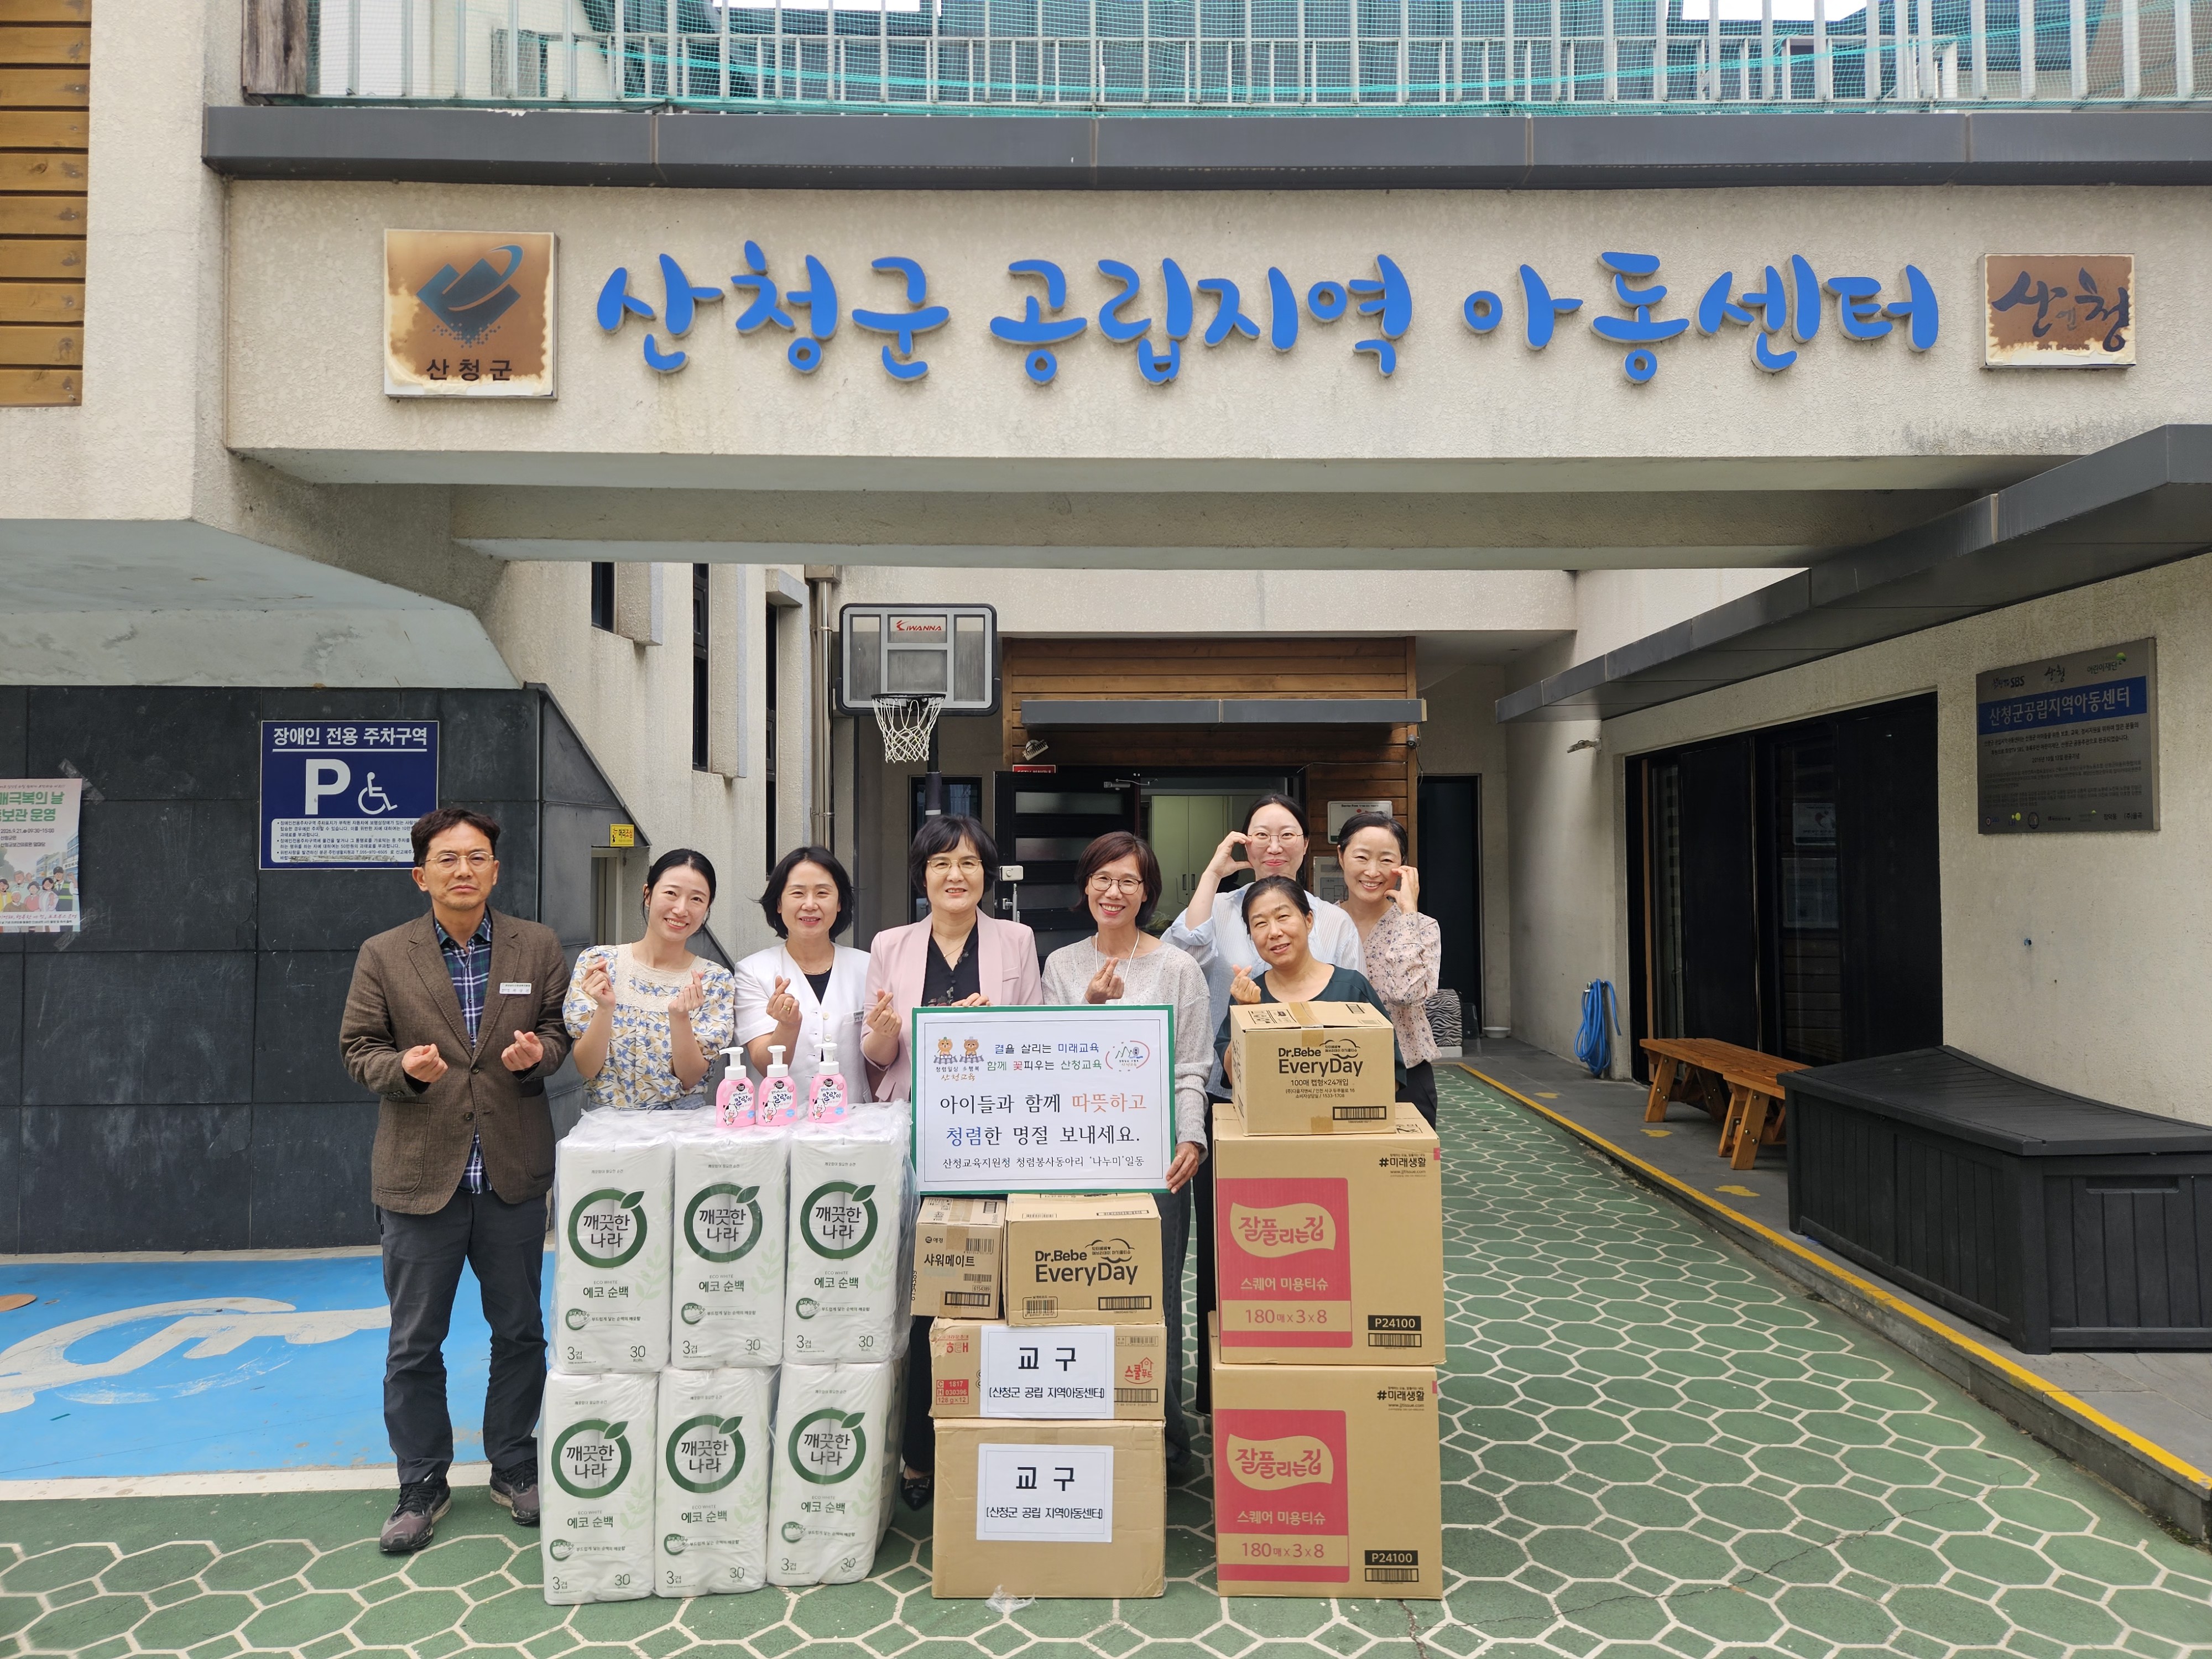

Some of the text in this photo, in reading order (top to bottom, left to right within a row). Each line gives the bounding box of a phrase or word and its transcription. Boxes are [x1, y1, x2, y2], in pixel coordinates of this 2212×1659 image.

[597, 240, 1939, 385] 산청군 공립지역 아동센터
[426, 359, 512, 381] 산청군
[896, 620, 942, 631] KIWANNA
[2088, 662, 2117, 675] 어린이재단
[2011, 676, 2025, 687] SBS
[1989, 686, 2129, 726] 산청군공립지역아동센터
[274, 727, 427, 745] 장애인 전용 주차구역
[305, 759, 351, 815] P
[51, 791, 65, 805] 날
[0, 808, 56, 822] 보관 운영
[995, 1042, 1099, 1054] 결을 살리는 미래교육
[1279, 1047, 1321, 1057] Dr.Bebe
[987, 1059, 1102, 1071] 함께 꽃피우는 산청교육
[1279, 1058, 1363, 1077] EveryDay
[940, 1092, 1147, 1114] 아이들과 함께 따뜻하고
[946, 1124, 1140, 1147] 청렴한 명절 보내세요.
[942, 1157, 1010, 1169] 산청교육지원청
[1016, 1156, 1083, 1168] 청렴봉사동아리
[1379, 1157, 1426, 1168] #미래생활
[699, 1209, 746, 1225] 깨끗한
[816, 1206, 862, 1223] 깨끗한
[583, 1214, 630, 1232] 깨끗한
[707, 1227, 739, 1243] 나라
[823, 1224, 854, 1239] 나라
[1238, 1215, 1323, 1246] 잘풀리는집
[591, 1233, 623, 1248] 나라
[924, 1253, 975, 1267] 샤워메이트
[1035, 1249, 1087, 1262] Dr.Bebe
[1036, 1262, 1138, 1286] EveryDay
[699, 1280, 744, 1293] 에코 순백
[814, 1277, 859, 1288] 에코 순백
[1240, 1277, 1328, 1292] 스퀘어 미용티슈
[583, 1286, 629, 1298] 에코 순백
[1375, 1318, 1416, 1328] P24100
[682, 1340, 697, 1354] 3겹
[745, 1339, 760, 1351] 30
[796, 1334, 811, 1348] 3겹
[858, 1335, 874, 1348] 30
[567, 1346, 582, 1360] 3겹
[630, 1345, 646, 1358] 30
[1125, 1364, 1152, 1380] 스쿨푸드
[1025, 1387, 1043, 1398] 공립
[1377, 1390, 1425, 1401] #미래생활
[681, 1439, 729, 1457] 깨끗한
[804, 1433, 851, 1449] 깨끗한
[566, 1444, 614, 1462] 깨끗한
[811, 1451, 842, 1466] 나라
[689, 1458, 722, 1473] 나라
[1235, 1448, 1321, 1479] 잘풀리는집
[575, 1463, 607, 1479] 나라
[801, 1501, 846, 1514] 에코 순백
[1022, 1507, 1041, 1519] 공립
[567, 1516, 613, 1529] 에코 순백
[681, 1510, 727, 1524] 에코 순백
[1237, 1511, 1326, 1526] 스퀘어 미용티슈
[781, 1558, 796, 1571] 3겹
[841, 1557, 856, 1570] 30
[1371, 1553, 1412, 1563] P24100
[614, 1573, 630, 1586] 30
[666, 1571, 681, 1584] 3겹
[729, 1567, 744, 1579] 30
[552, 1576, 567, 1590] 3겹
